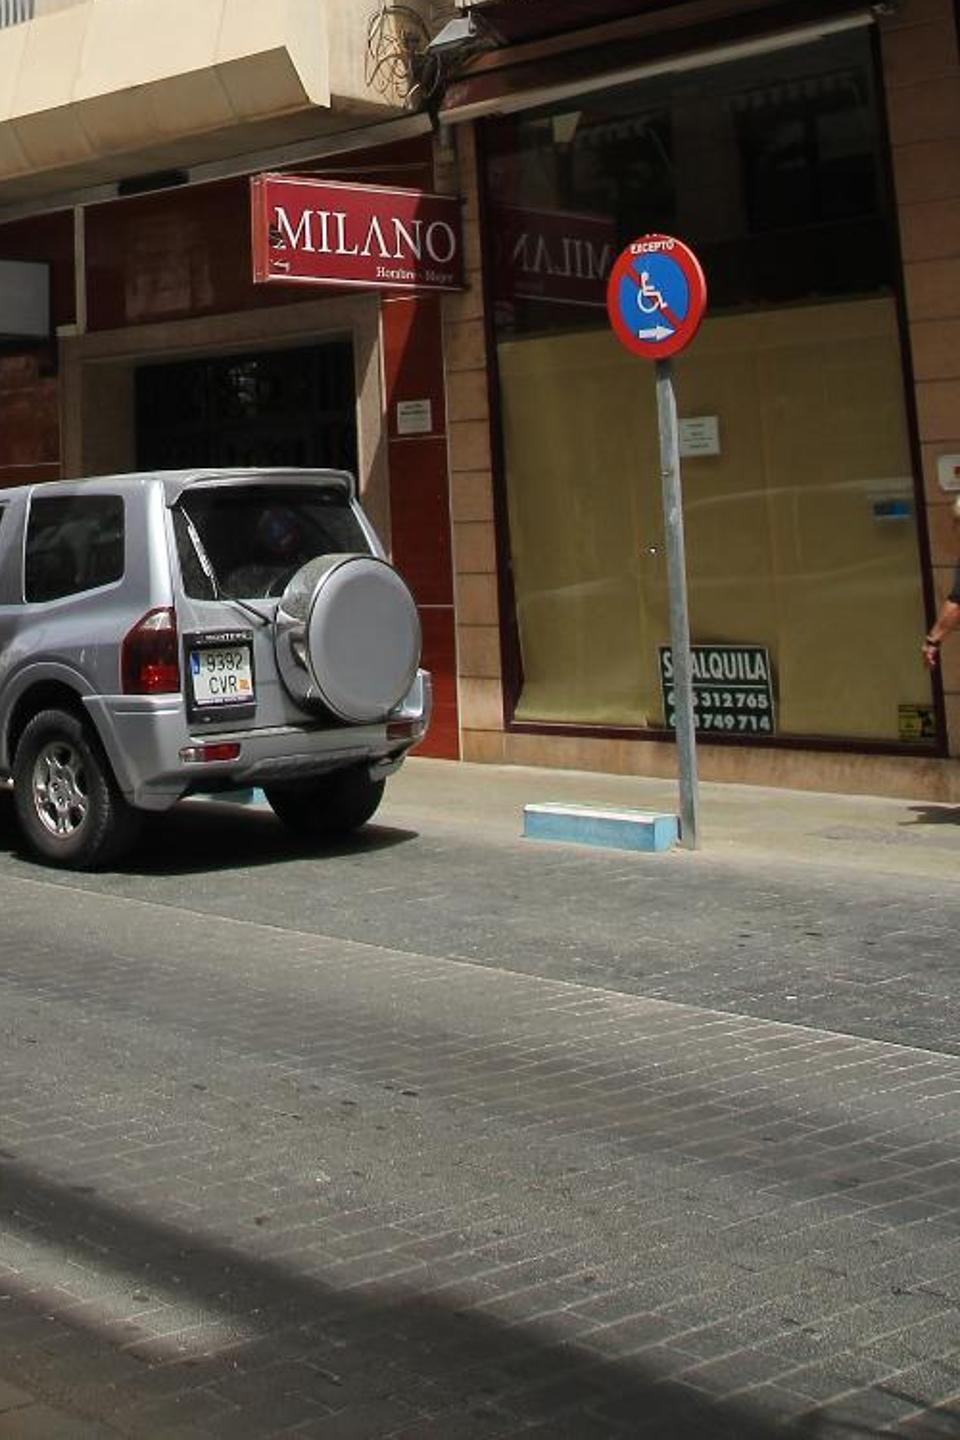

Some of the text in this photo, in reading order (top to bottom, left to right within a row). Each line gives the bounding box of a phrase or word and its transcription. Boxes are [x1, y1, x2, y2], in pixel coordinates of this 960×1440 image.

[273, 207, 456, 263] MILANO
[630, 240, 675, 255] EXCEPTO
[208, 675, 238, 694] CVR
